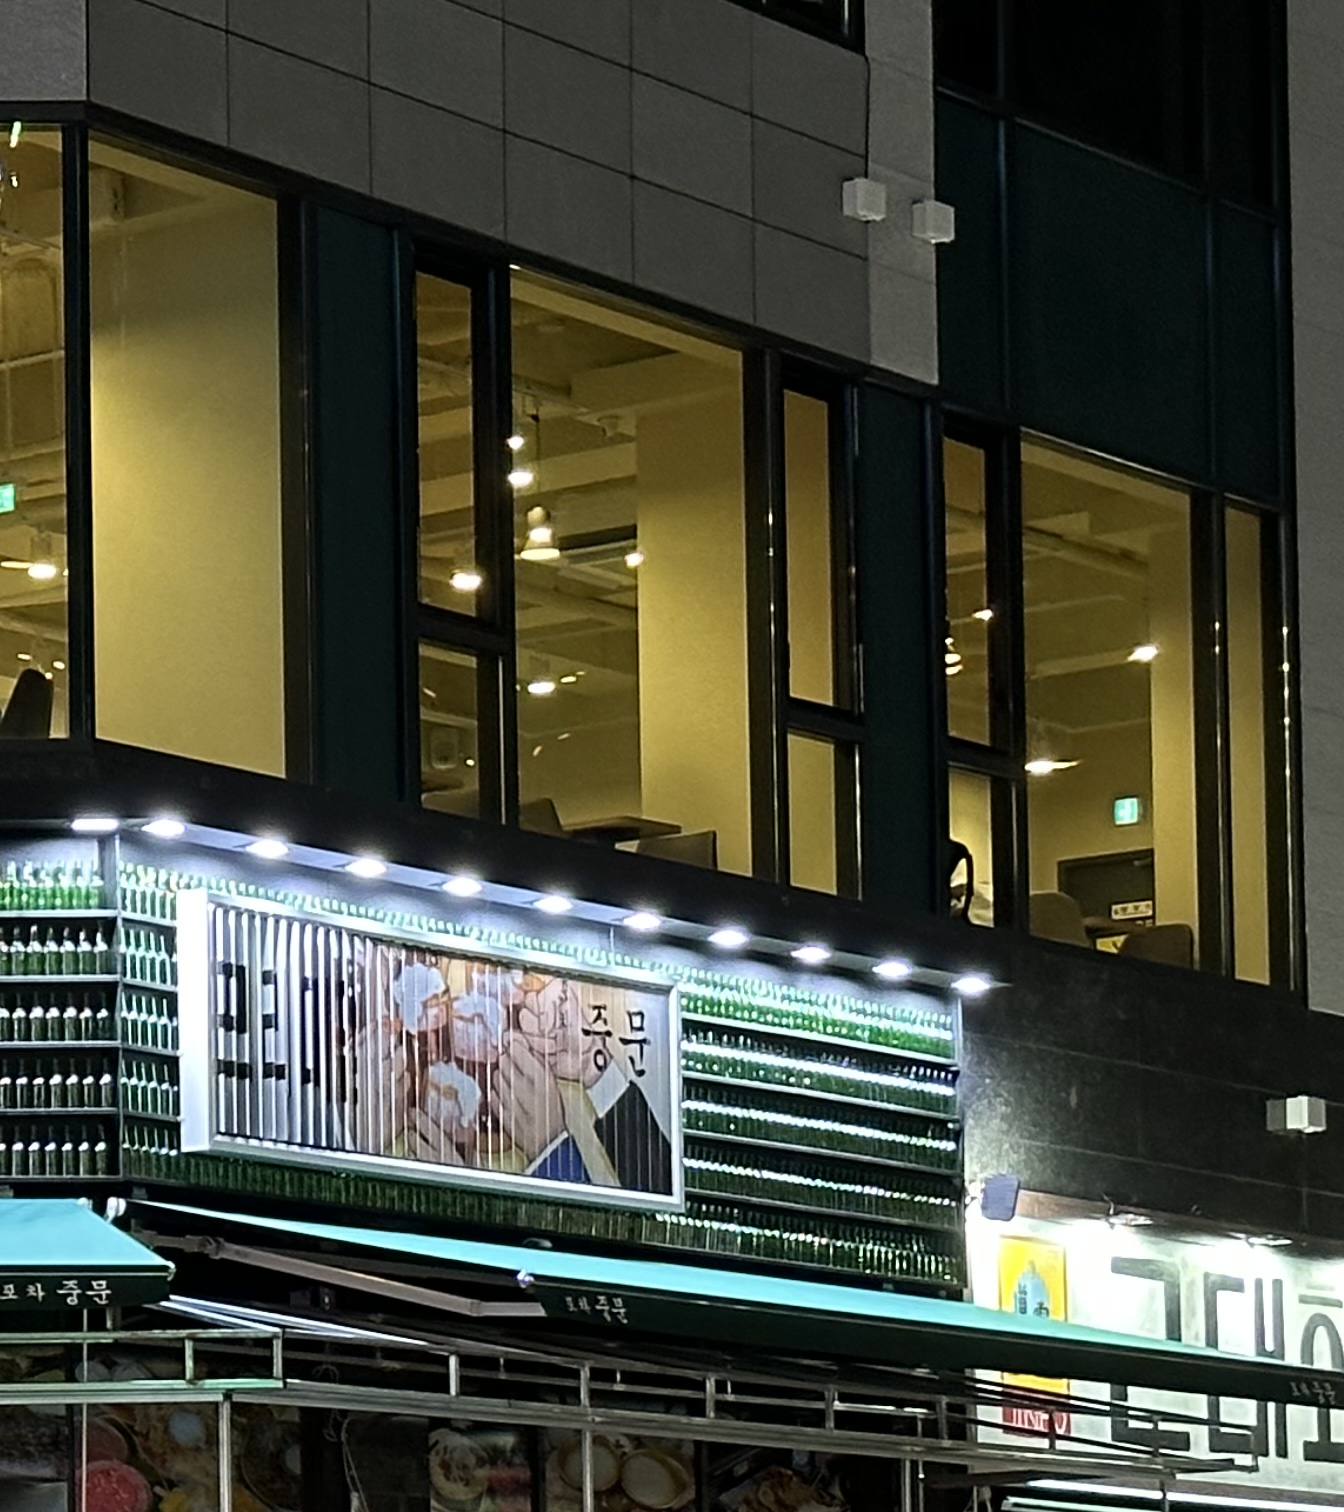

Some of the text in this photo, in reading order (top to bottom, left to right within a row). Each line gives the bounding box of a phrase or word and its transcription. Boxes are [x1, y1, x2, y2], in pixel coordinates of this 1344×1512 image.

[580, 1003, 652, 1078] 중문
[55, 1279, 112, 1306] 중문
[594, 1295, 629, 1325] 중문
